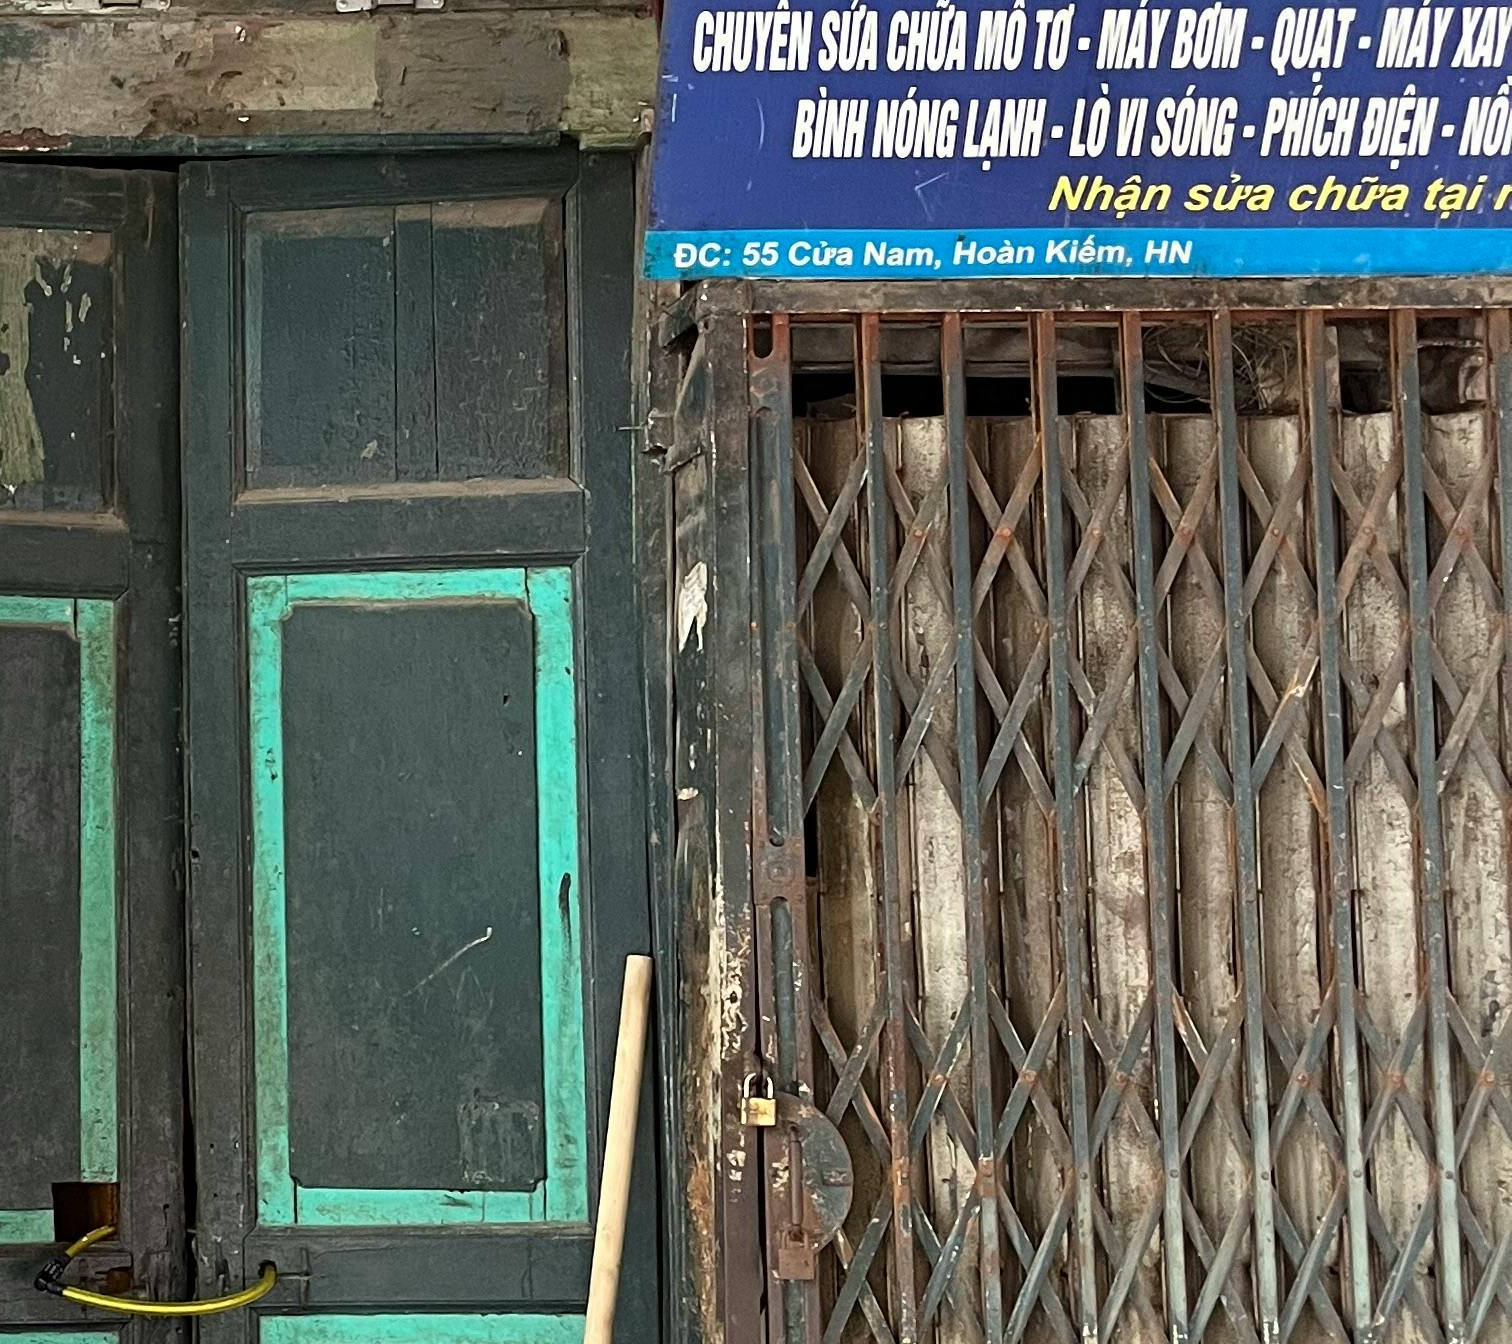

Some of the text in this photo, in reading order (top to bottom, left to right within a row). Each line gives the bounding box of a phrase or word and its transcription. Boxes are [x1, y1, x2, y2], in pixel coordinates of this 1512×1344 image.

[887, 0, 967, 71] CHỮA
[1033, 4, 1075, 71] TƠ
[1171, 2, 1248, 69] BƠM
[1270, 7, 1357, 83] QUẠT
[1450, 6, 1512, 68] XAY
[792, 87, 868, 158] BÌNH
[872, 87, 960, 158] NÓNG
[963, 98, 1047, 171] LẠNH
[1069, 83, 1111, 157] LÒ
[1116, 98, 1149, 157] VI
[1151, 84, 1239, 157] SÓNG
[1260, 85, 1359, 157] PHÍCH
[1359, 83, 1439, 170] ĐIỆN
[1048, 174, 1172, 219] Nhận
[1184, 172, 1275, 212] sửa
[1289, 176, 1410, 212] chữa
[1423, 174, 1488, 219] tại
[673, 234, 1192, 270] ĐC: 55 Cửa Nam, Hoàn Kiếm, HN
